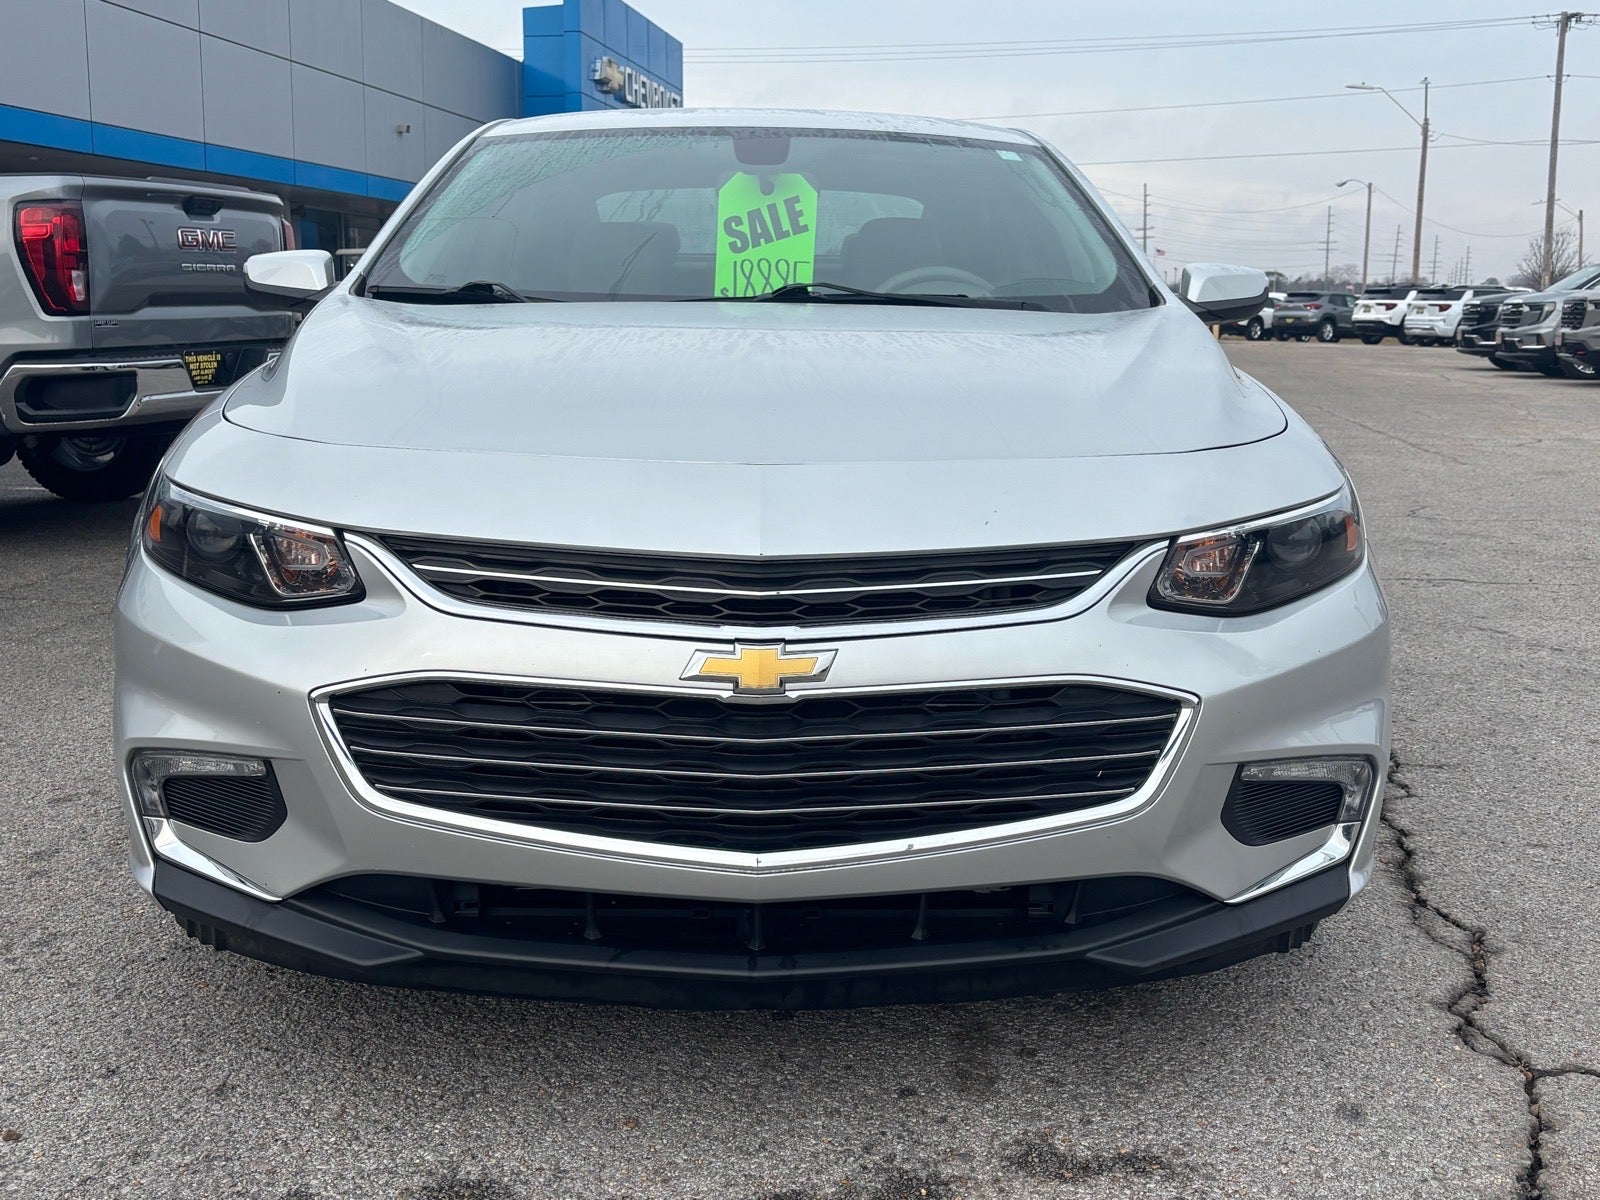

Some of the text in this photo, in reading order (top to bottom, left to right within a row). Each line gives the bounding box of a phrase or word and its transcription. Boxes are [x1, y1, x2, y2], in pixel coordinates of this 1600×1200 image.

[723, 195, 809, 254] SALE
[178, 228, 237, 250] GMC
[181, 263, 236, 271] SIERRA
[185, 355, 196, 363] THIS
[197, 354, 215, 362] VEHICLE
